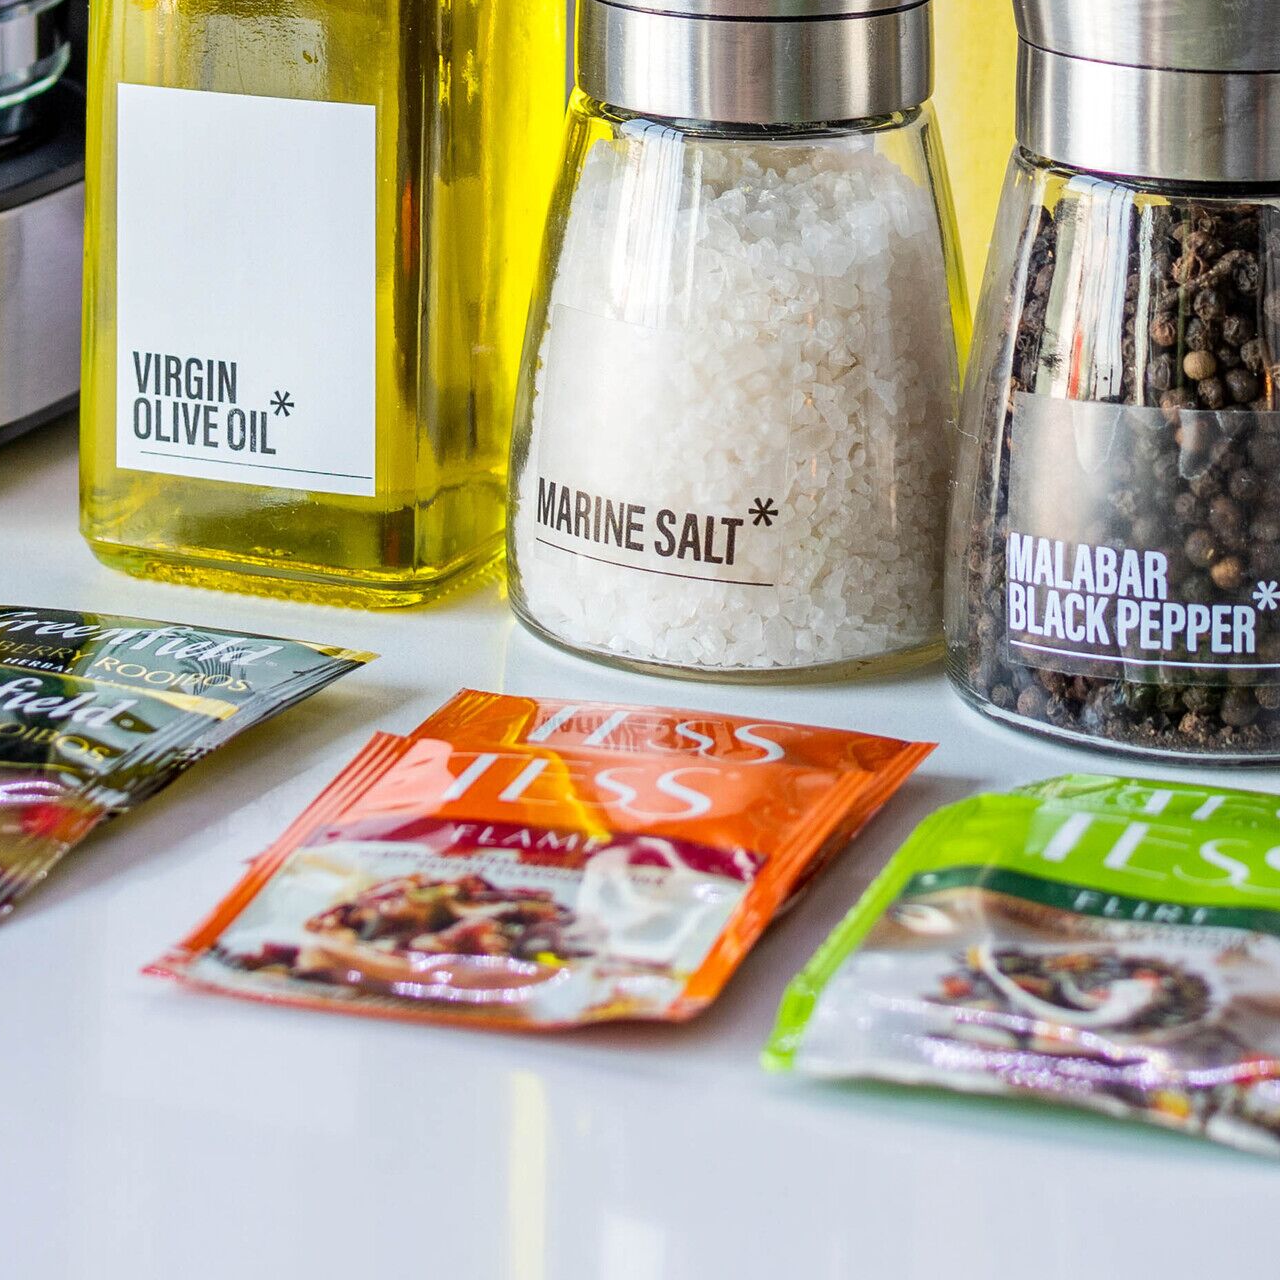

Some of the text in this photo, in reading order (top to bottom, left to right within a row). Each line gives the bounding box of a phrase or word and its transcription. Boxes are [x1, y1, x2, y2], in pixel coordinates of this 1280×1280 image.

[132, 351, 237, 404] VIRGIN
[133, 397, 218, 449] OLIVE
[537, 477, 645, 552] MARINE
[1009, 532, 1168, 600] MALABAR
[1009, 582, 1110, 645] BLACK
[93, 656, 258, 693] ROOIBOS
[443, 752, 721, 819] TESS
[1074, 889, 1214, 925] FLIRT
